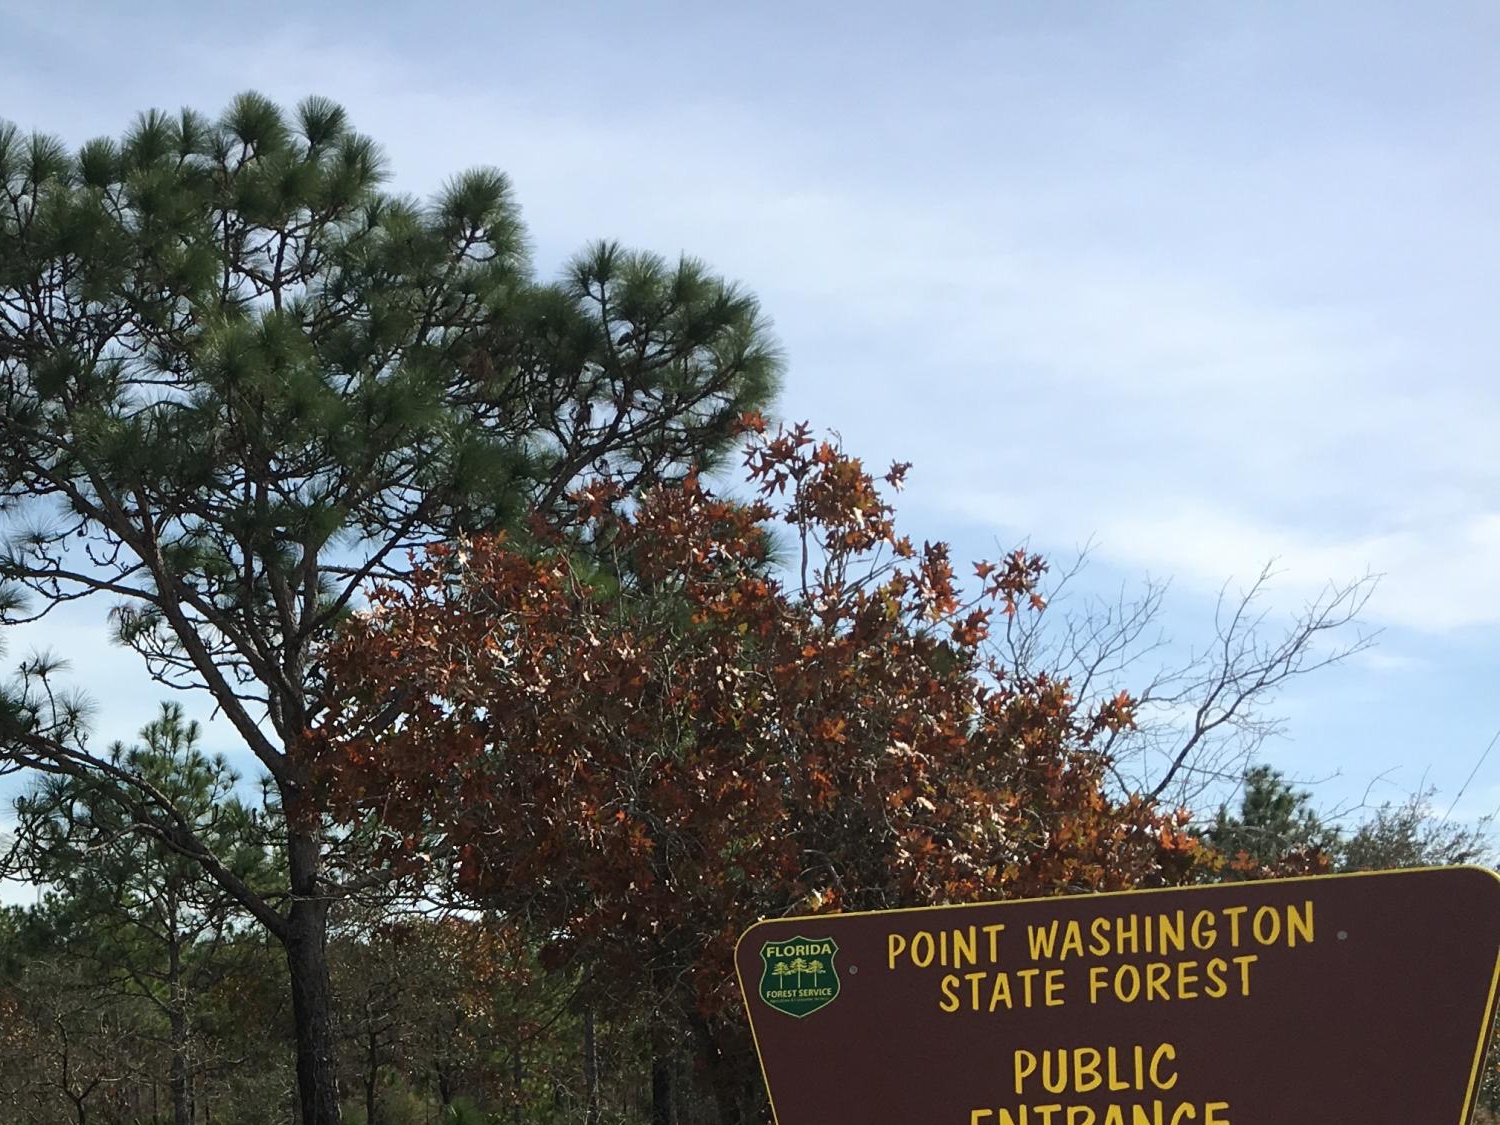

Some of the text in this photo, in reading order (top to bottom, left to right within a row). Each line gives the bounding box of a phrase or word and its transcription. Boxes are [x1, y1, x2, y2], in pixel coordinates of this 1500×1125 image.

[766, 943, 832, 957] FLORIDA
[887, 901, 1315, 970] POINT WASHINGTON
[766, 988, 832, 998] FOREST SERVICE
[938, 954, 1259, 1013] STATE FOREST
[1013, 1043, 1179, 1095] PUBLIC
